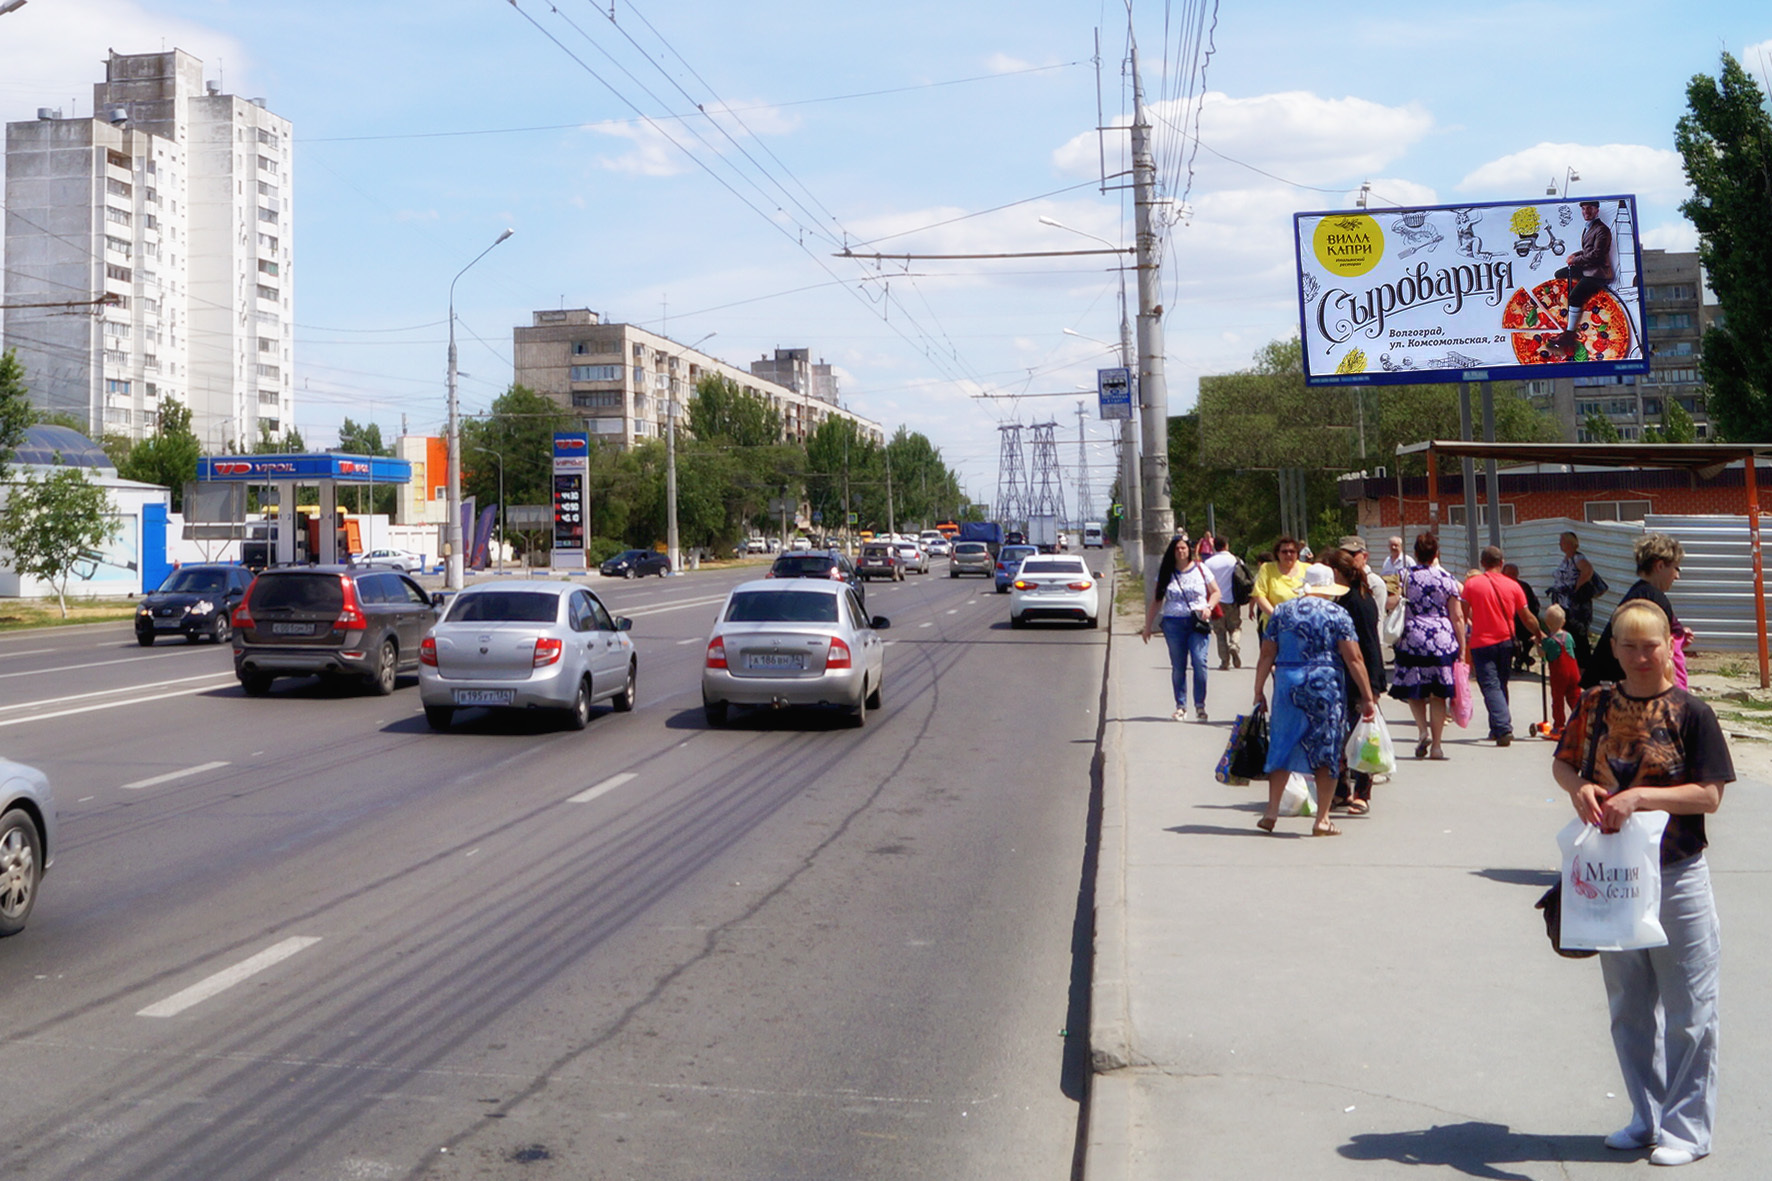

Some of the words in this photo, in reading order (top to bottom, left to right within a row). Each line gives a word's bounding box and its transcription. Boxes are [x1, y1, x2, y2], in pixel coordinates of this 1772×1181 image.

[1327, 233, 1370, 244] ВИЛЛА
[1327, 244, 1372, 256] КАПРИ
[1316, 261, 1515, 348] Сыроварня
[1389, 327, 1446, 338] Волгоград,
[1390, 341, 1404, 350] ул.
[1408, 336, 1491, 347] Комсомольская,
[1494, 335, 1506, 343] 2а
[255, 463, 296, 472] VIPOIL
[1586, 861, 1640, 881] Магия
